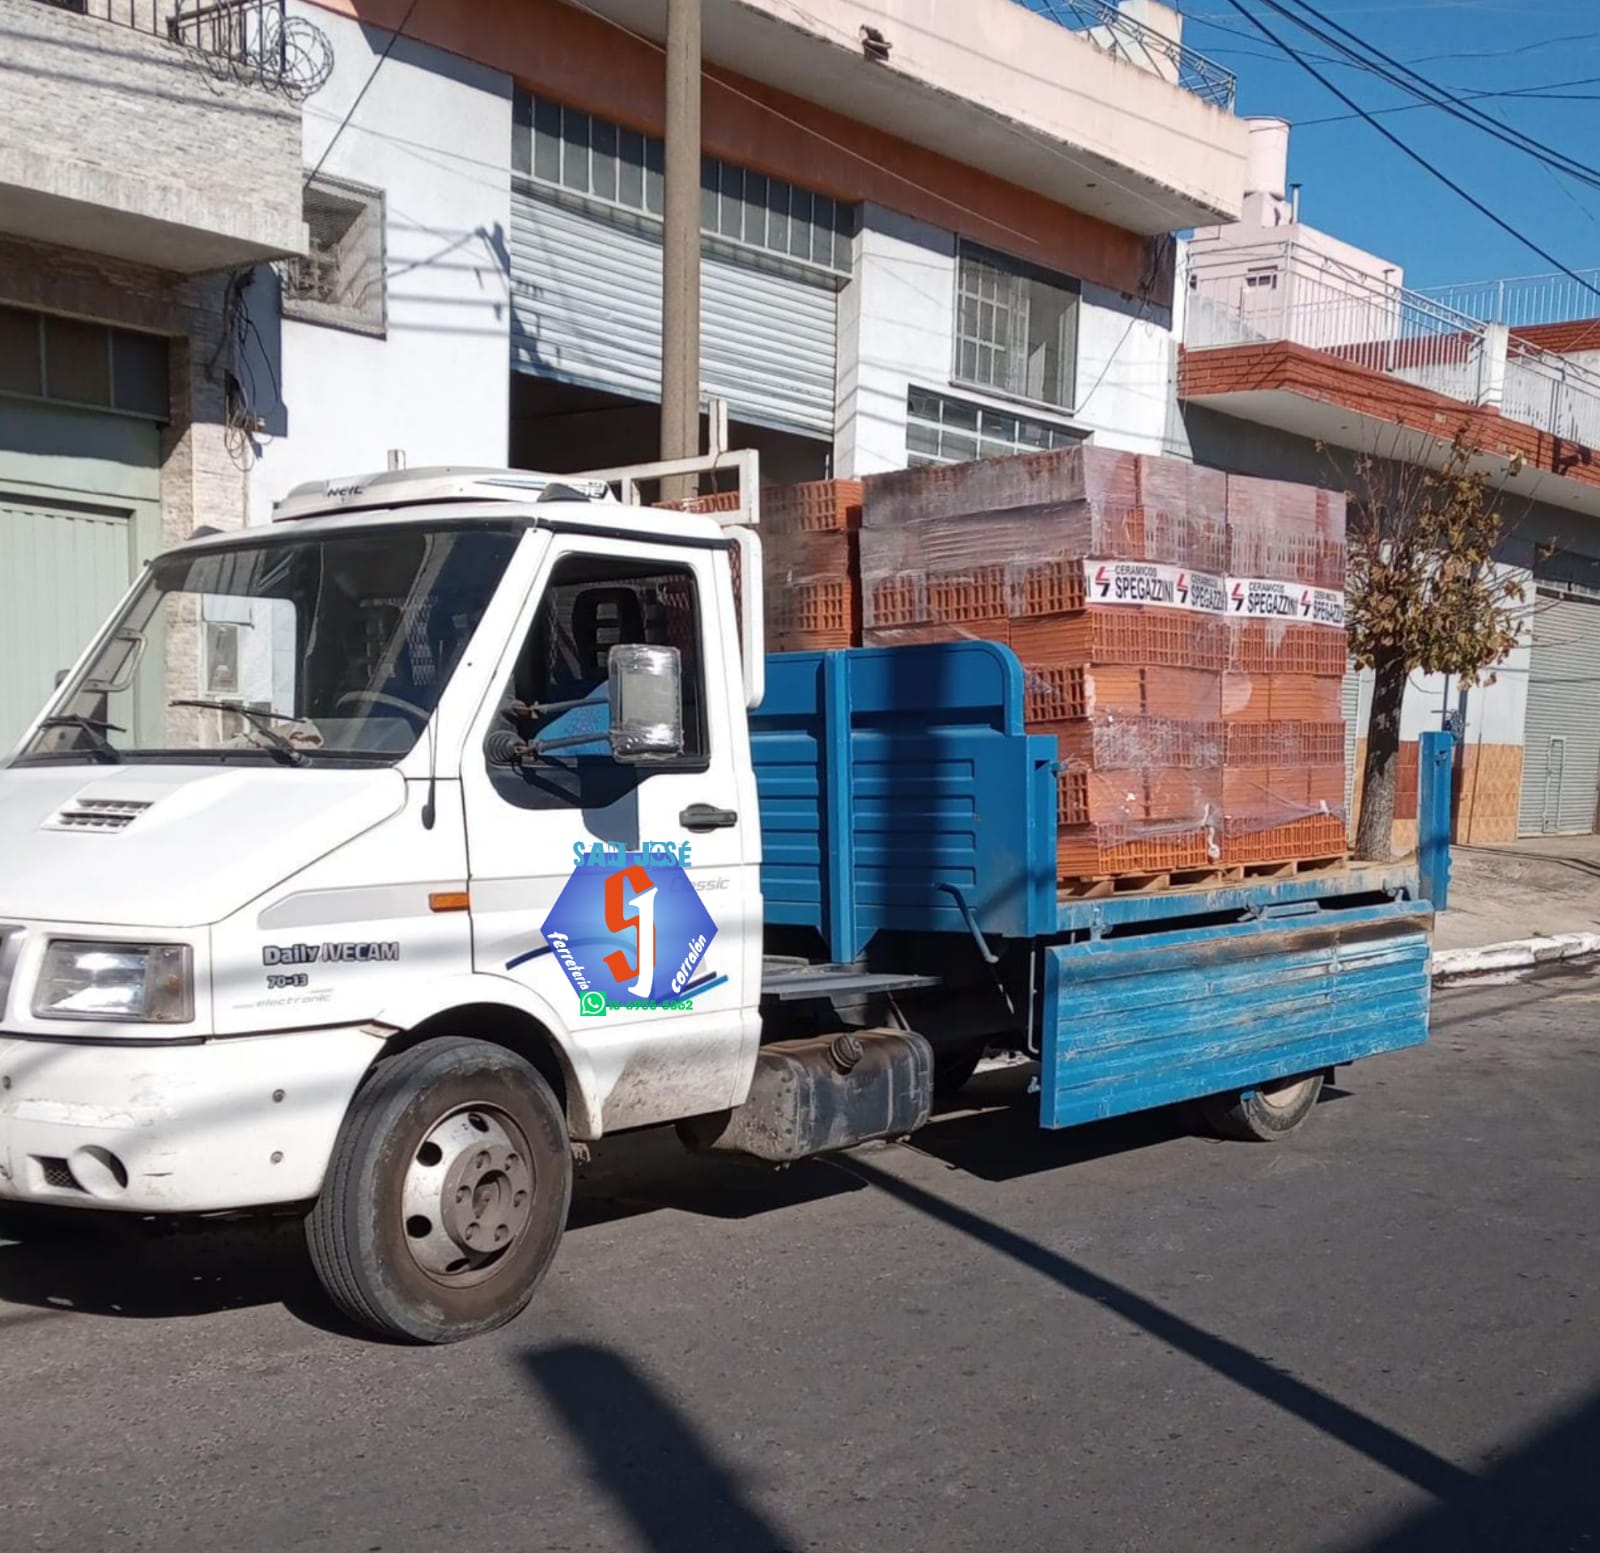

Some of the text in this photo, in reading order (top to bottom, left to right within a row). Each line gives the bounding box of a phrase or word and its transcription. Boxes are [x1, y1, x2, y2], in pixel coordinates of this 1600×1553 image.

[1115, 576, 1174, 602] SPEGAZZINI
[262, 942, 400, 966] Daily IVECAM
[266, 973, 309, 989] 70-13
